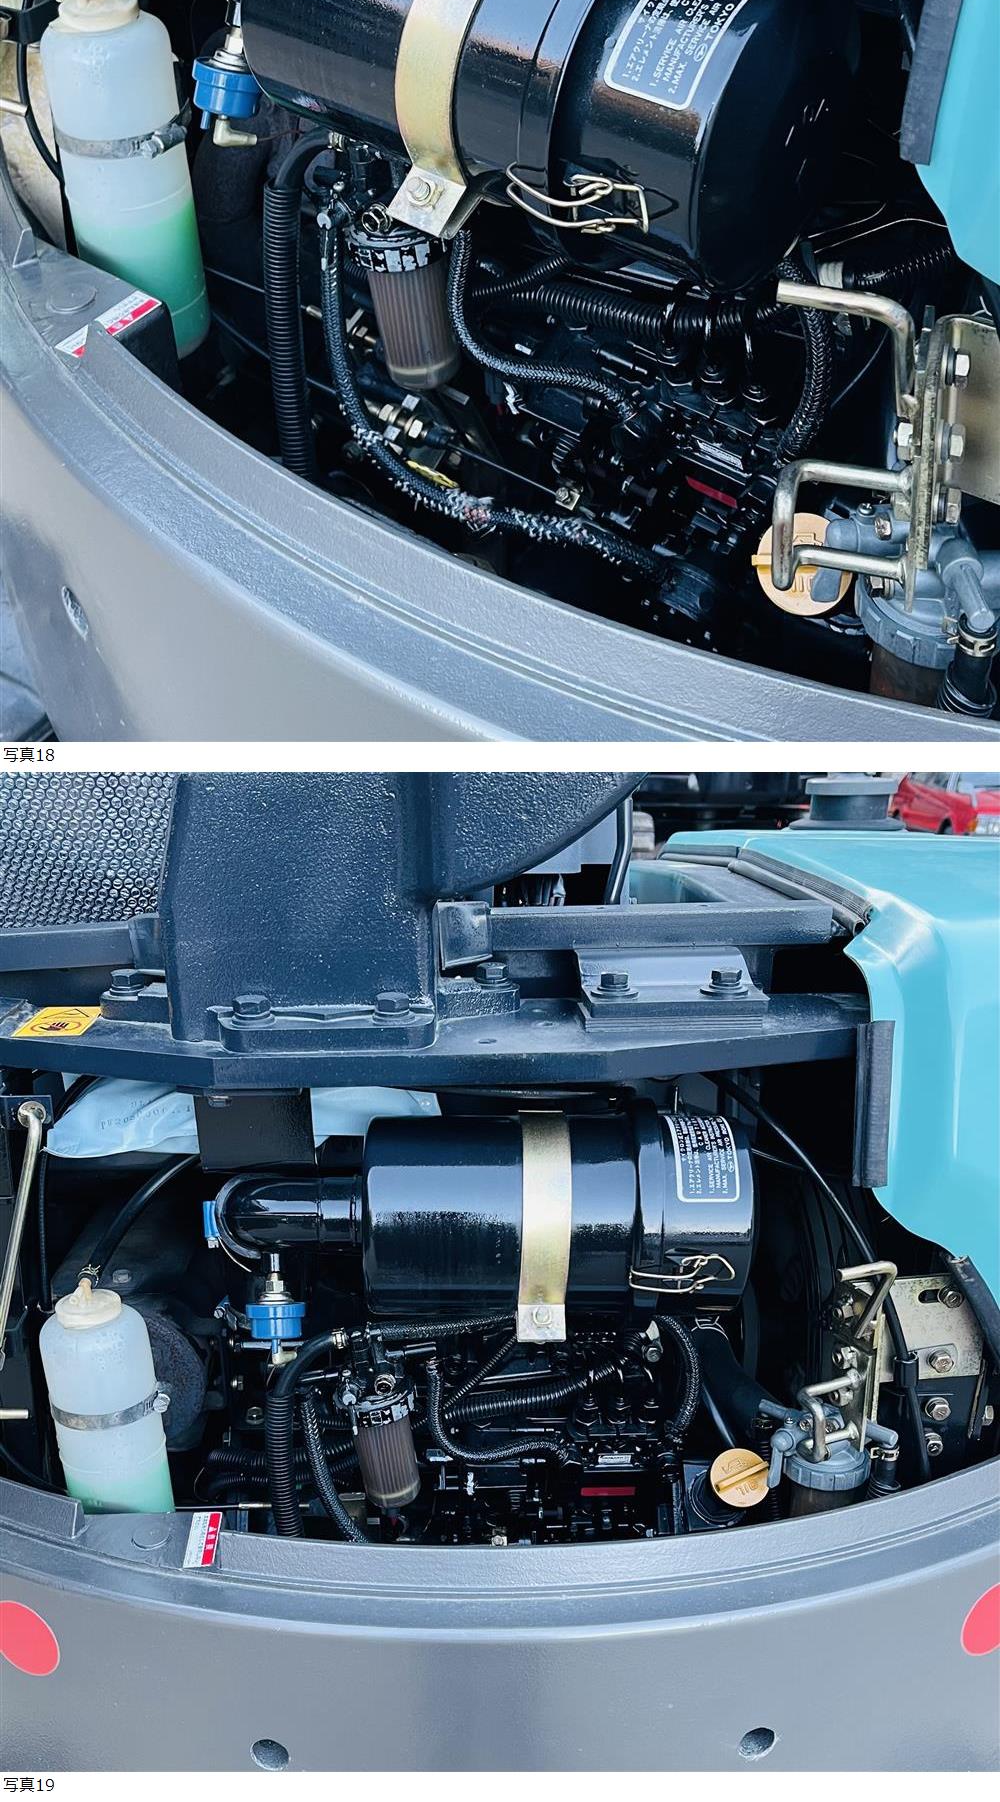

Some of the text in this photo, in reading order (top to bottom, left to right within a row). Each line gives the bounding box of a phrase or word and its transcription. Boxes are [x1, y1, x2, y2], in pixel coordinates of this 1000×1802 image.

[662, 3, 710, 81] MANUFACTURER'S
[675, 19, 688, 35] AIR
[685, 17, 711, 56] SERVICE
[709, 1, 723, 16] AIR
[704, 1, 735, 43] TOKYO
[723, 1137, 733, 1159] TOKYO
